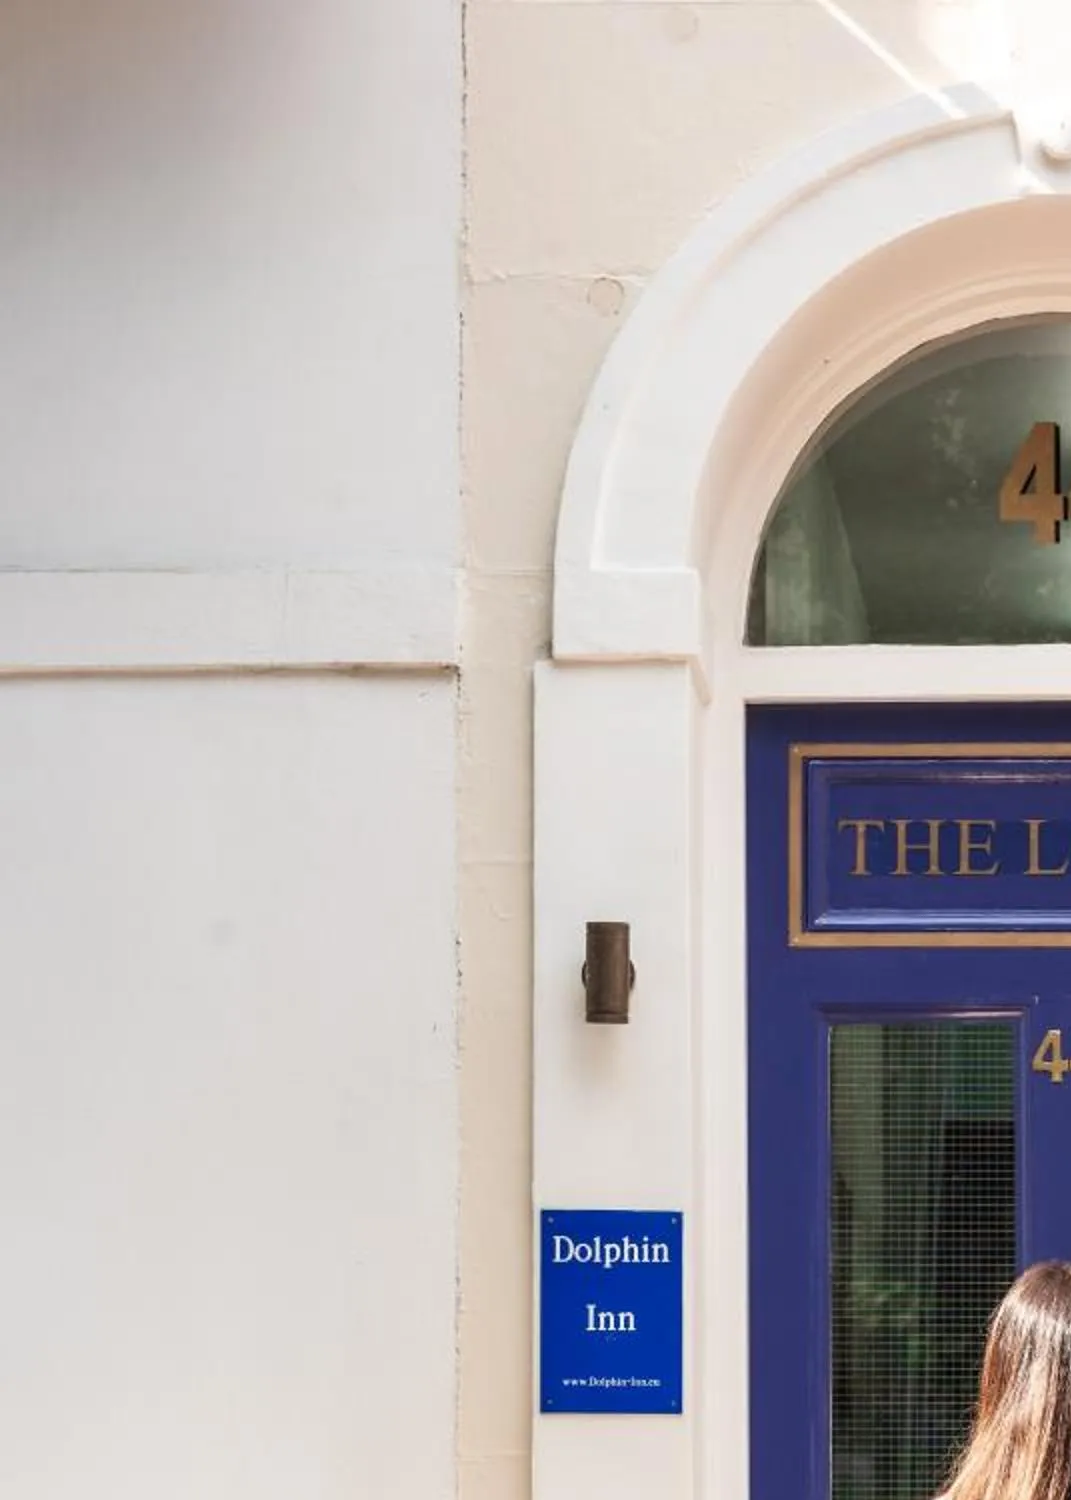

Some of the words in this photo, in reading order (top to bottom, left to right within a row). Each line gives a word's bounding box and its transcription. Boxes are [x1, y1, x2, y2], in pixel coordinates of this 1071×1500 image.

[837, 818, 1000, 876] THE
[552, 1234, 671, 1269] Dolphin
[585, 1303, 637, 1332] Inn
